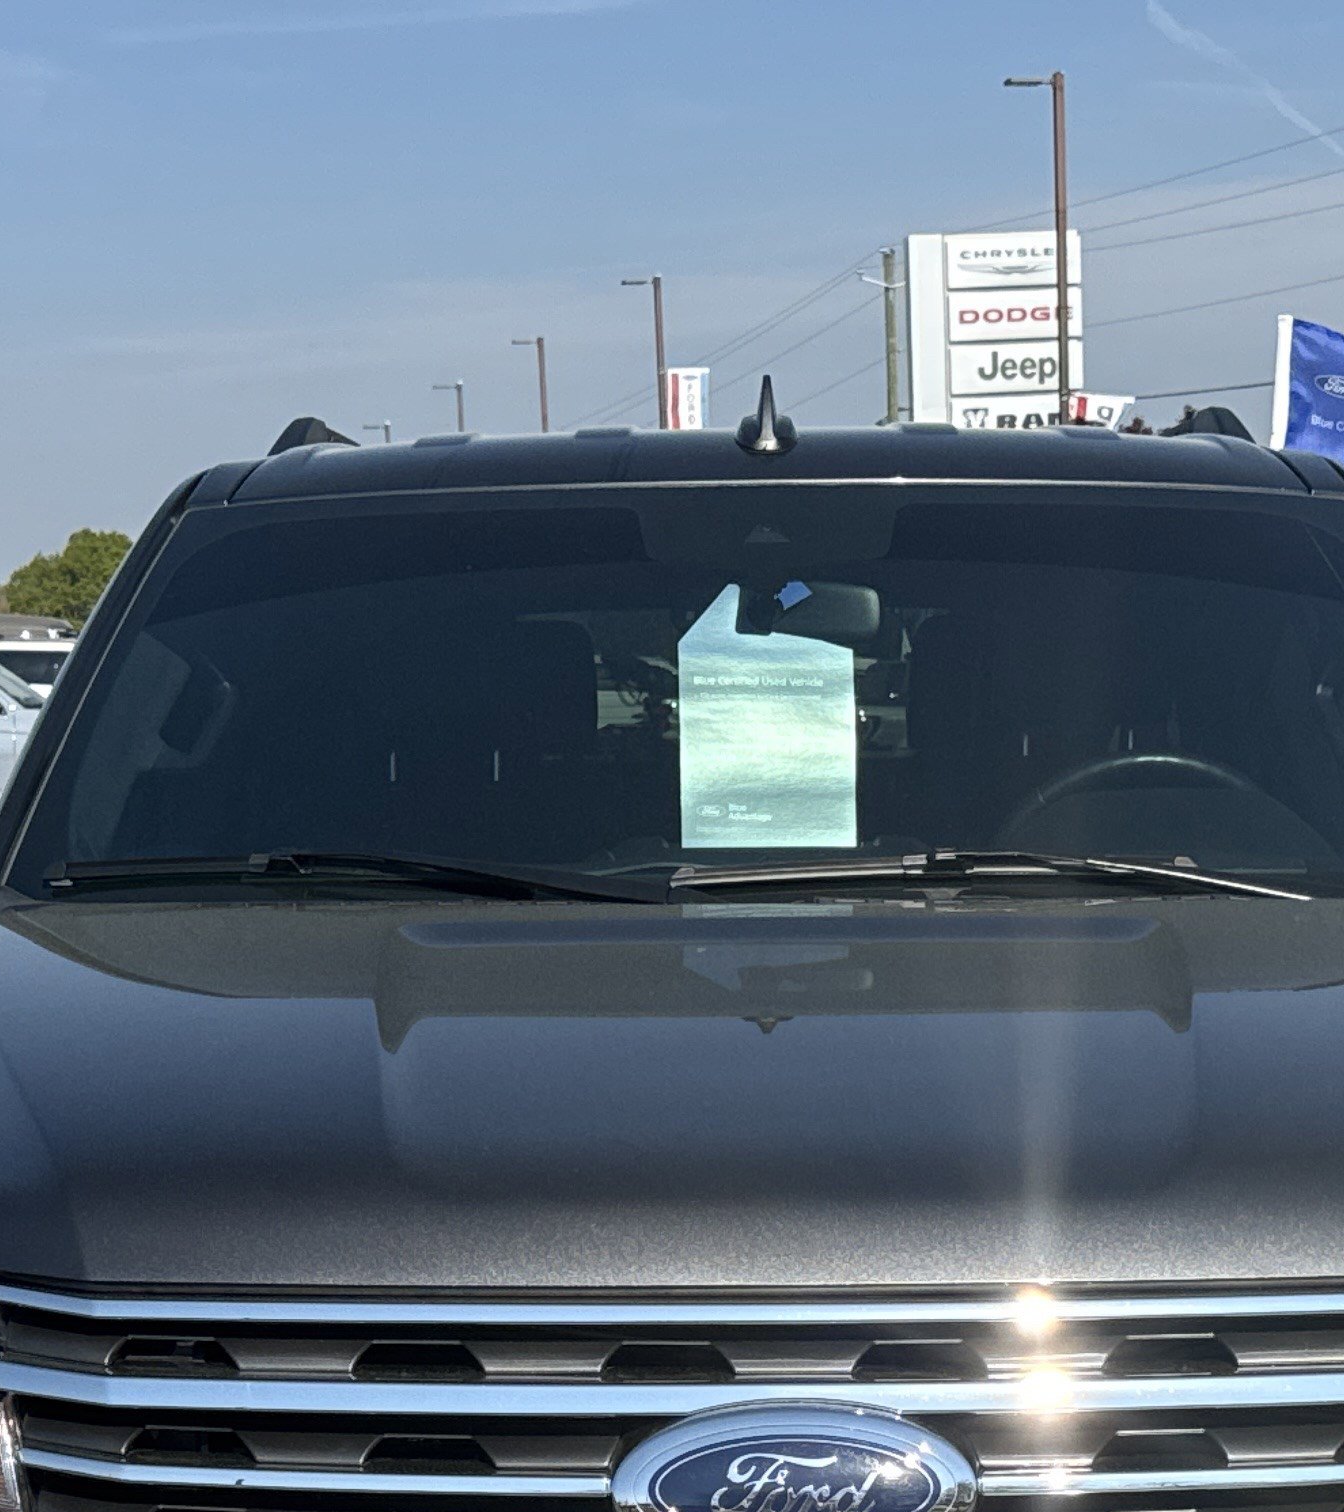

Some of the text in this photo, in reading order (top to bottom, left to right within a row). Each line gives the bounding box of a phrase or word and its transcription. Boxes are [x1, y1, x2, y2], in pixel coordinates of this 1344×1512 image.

[959, 247, 1055, 260] CHRYSLE
[978, 350, 1057, 385] Jeep
[1311, 414, 1334, 429] Blue
